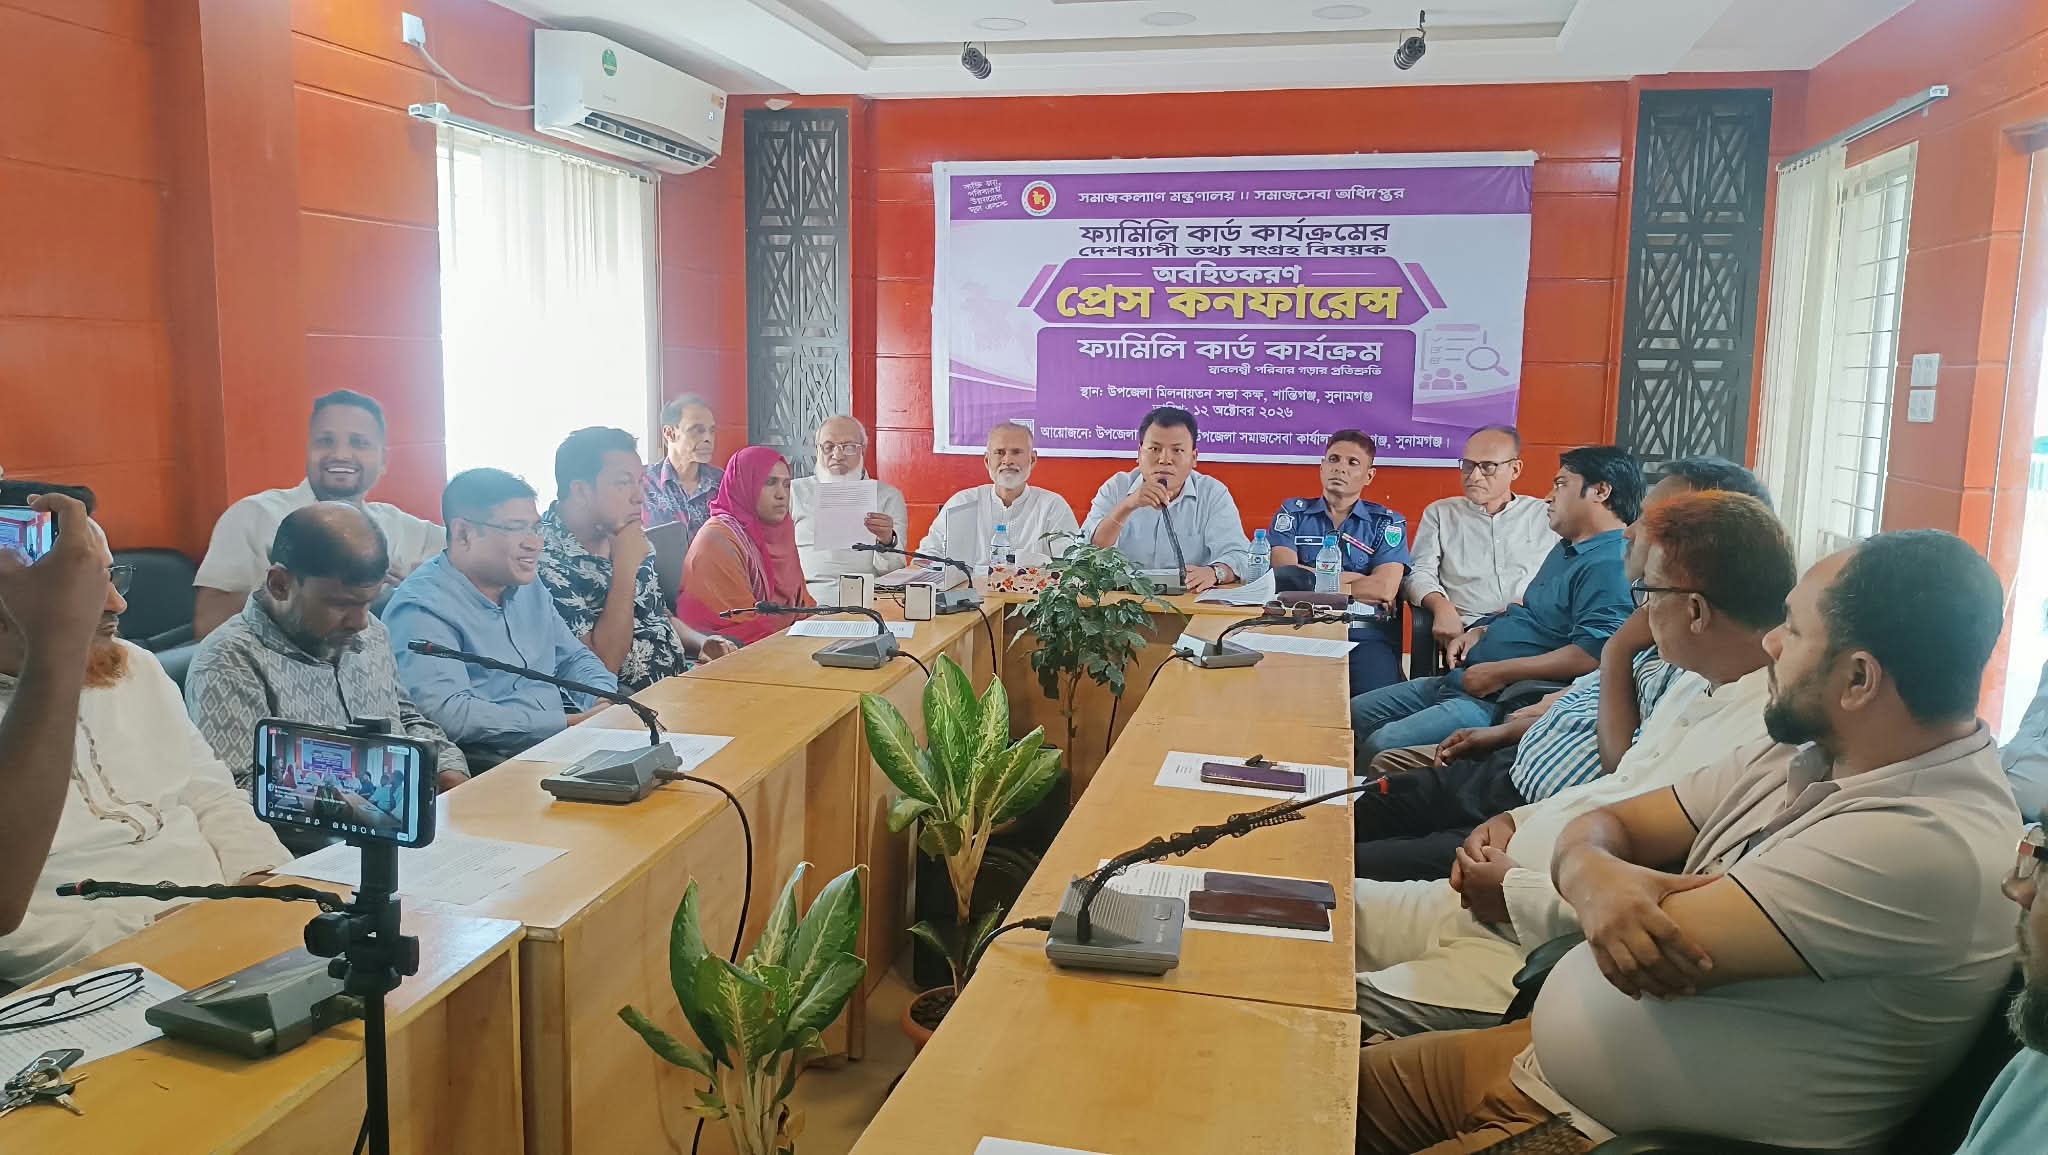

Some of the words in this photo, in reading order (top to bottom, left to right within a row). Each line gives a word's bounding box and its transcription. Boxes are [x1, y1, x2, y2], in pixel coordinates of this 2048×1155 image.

[1078, 191, 1167, 204] সমাজকল্যাণ
[1169, 190, 1235, 204] মন্ত্রণালয়
[1254, 189, 1331, 201] সমাজসেবা
[1335, 184, 1405, 202] অধিদপ্তর
[1079, 219, 1179, 243] ফ্যামিলি
[1186, 218, 1243, 242] কার্ড
[1249, 217, 1390, 241] কার্যক্রমের
[1078, 242, 1179, 257] দেশব্যাপী
[1185, 244, 1233, 256] তথ্য
[1238, 244, 1301, 256] সংগ্রহ
[1306, 242, 1388, 256] বিষয়ক
[1151, 260, 1302, 284] অবহিতকরণ
[1056, 283, 1155, 319] প্রেস
[1165, 283, 1403, 319] কনফারেন্স
[1076, 332, 1187, 359] ফ্যামিলি
[1194, 333, 1257, 360] কার্ড
[1264, 334, 1384, 361] কার্যক্রম
[1208, 362, 1251, 375] স্বাবলম্বী
[1254, 363, 1296, 375] পরিবার
[1298, 366, 1328, 376] গড়ার
[1331, 364, 1383, 376] প্রতিশ্রুতি
[1107, 384, 1151, 399] উপজেলা
[1155, 385, 1213, 400] মিলনায়তন
[1215, 389, 1239, 400] সভা
[1240, 389, 1268, 403] কক্ষ,
[1272, 386, 1320, 404] শান্তিগঞ্জ,
[1324, 390, 1373, 405] সুনামগঞ্জ
[1193, 405, 1209, 416] ১২
[1212, 403, 1256, 417] অক্টোবর
[1259, 407, 1293, 418] ২০২৬
[1095, 425, 1139, 441] উপজেলা
[1239, 431, 1292, 445] সমাজসেবা
[1296, 430, 1333, 446] কার্যাল
[1395, 434, 1443, 450] সুনামগঞ্জ
